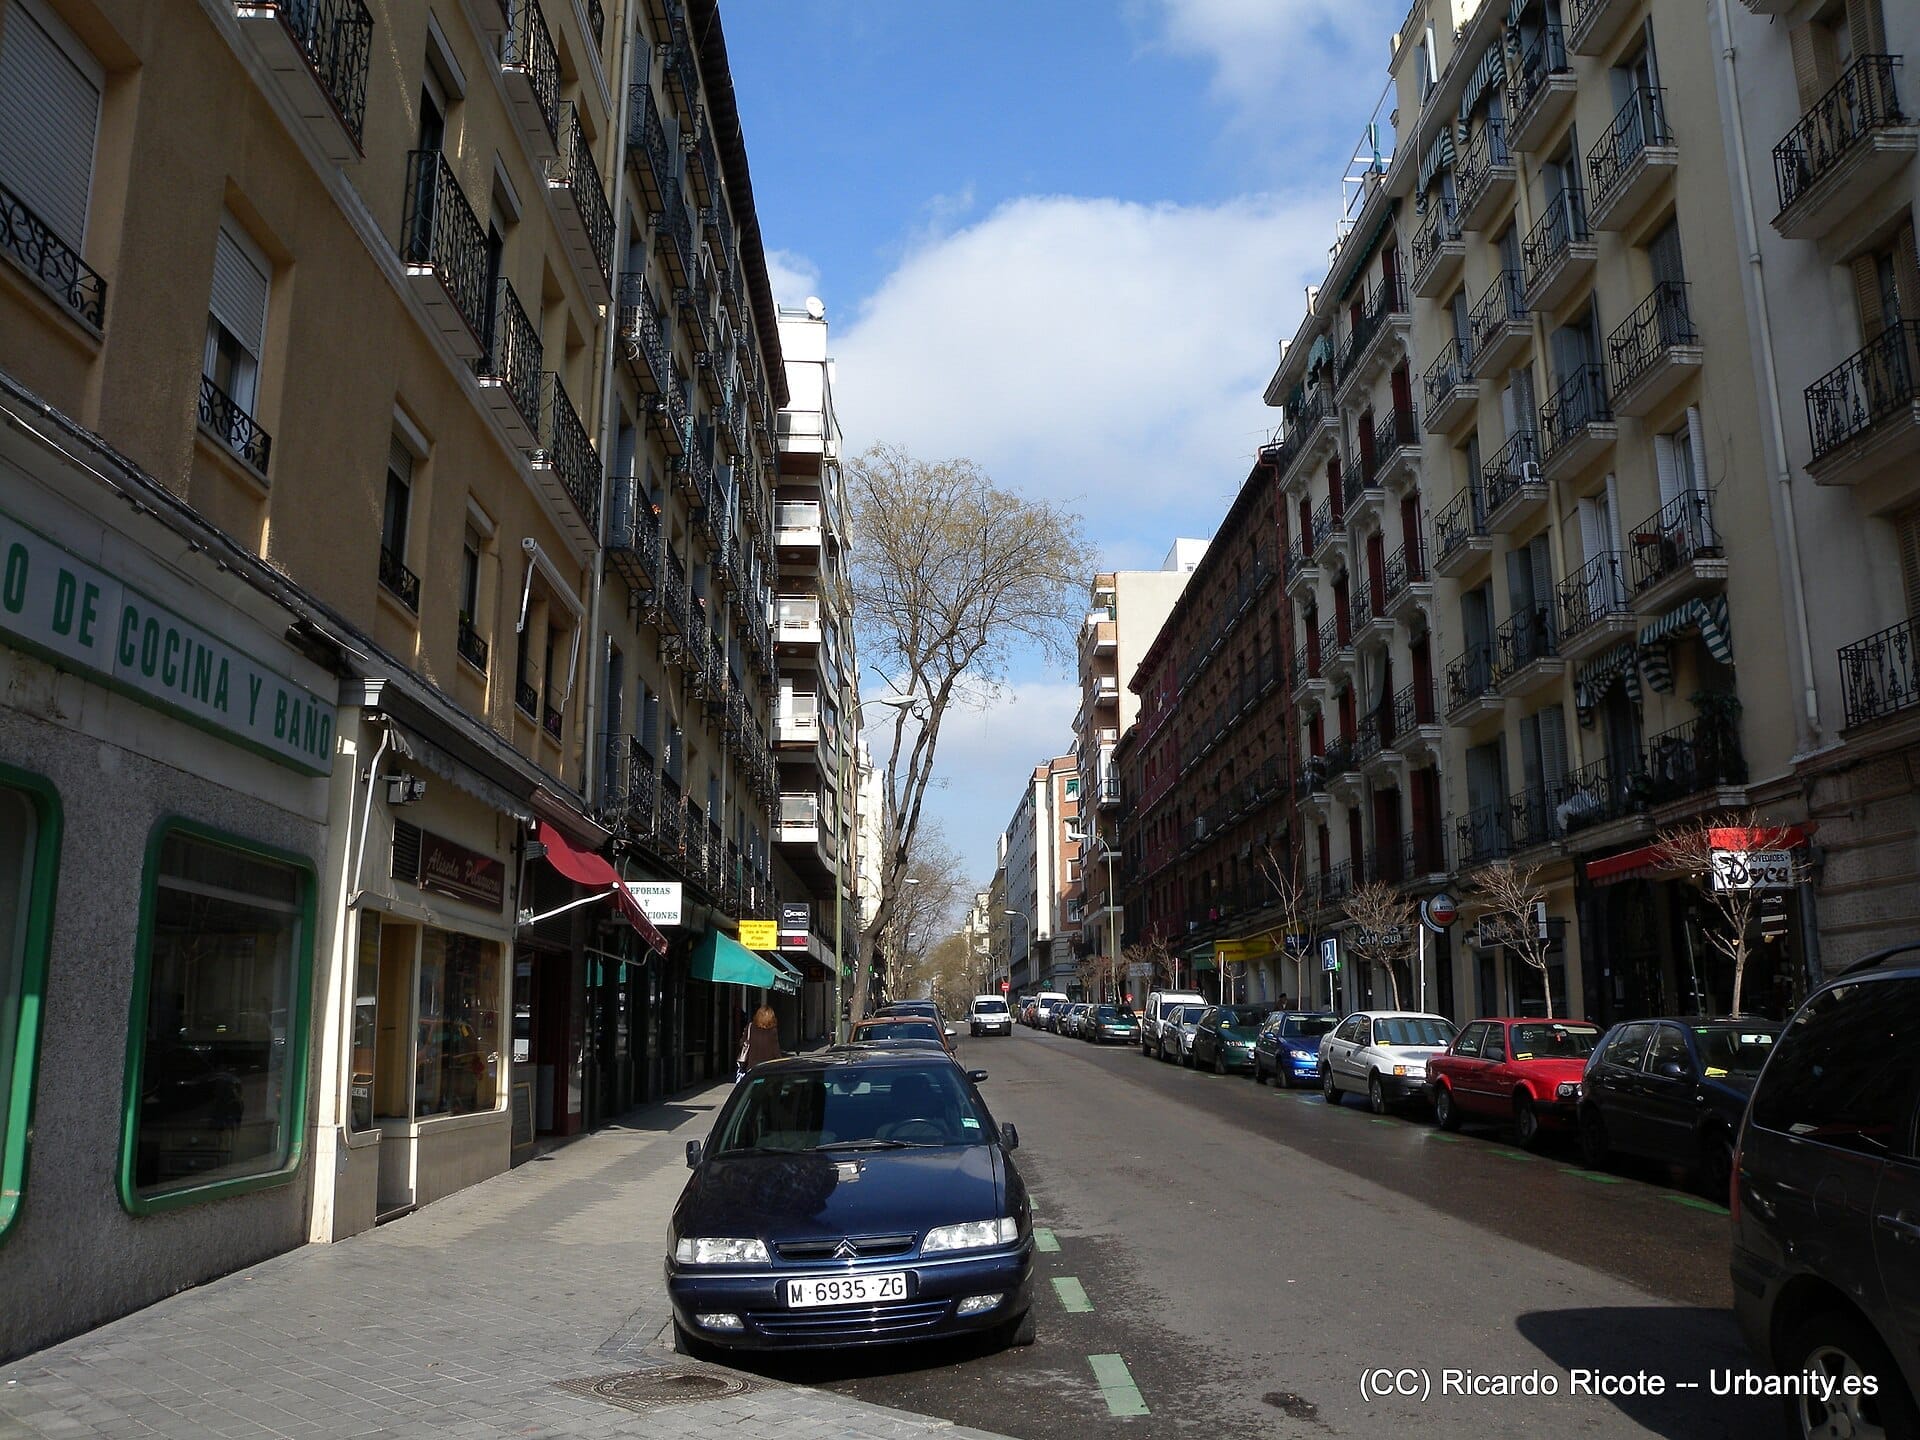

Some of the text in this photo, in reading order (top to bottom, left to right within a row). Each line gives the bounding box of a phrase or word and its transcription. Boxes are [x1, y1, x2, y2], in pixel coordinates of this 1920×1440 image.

[52, 567, 100, 648] DE
[119, 604, 230, 714] COCINA
[248, 672, 264, 726] Y
[274, 695, 331, 761] BAÑO
[629, 887, 671, 895] EFORMAS
[644, 899, 650, 907] Y
